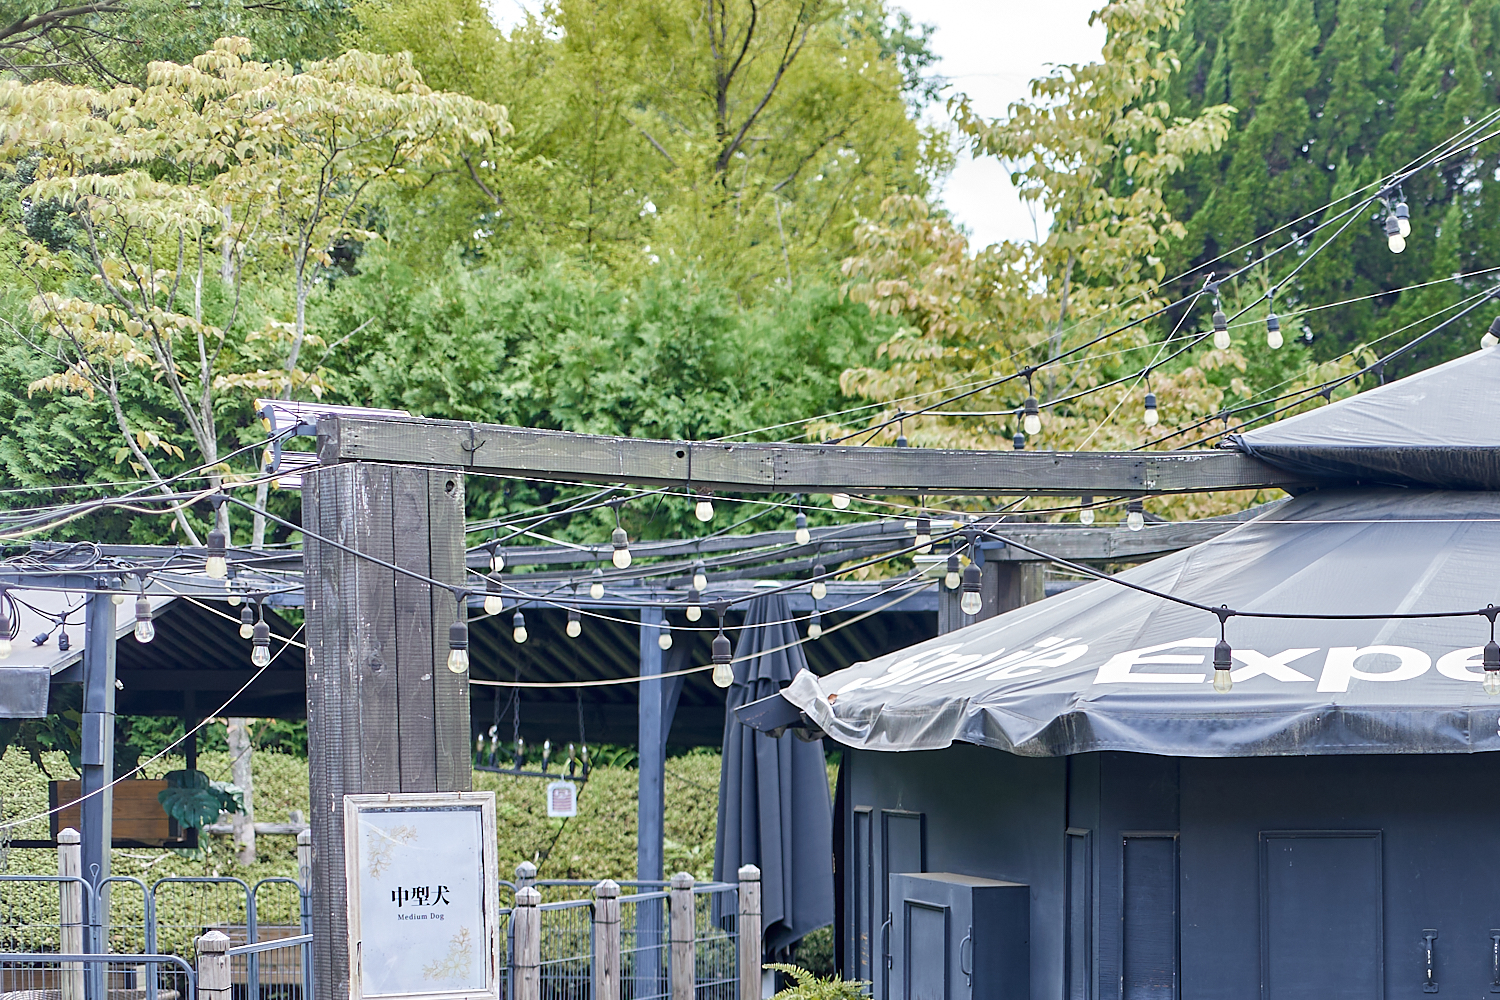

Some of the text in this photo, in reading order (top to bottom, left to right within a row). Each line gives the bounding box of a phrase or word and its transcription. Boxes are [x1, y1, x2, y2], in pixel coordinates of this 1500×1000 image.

[391, 885, 450, 908] 中型犬
[430, 912, 445, 921] Dog
